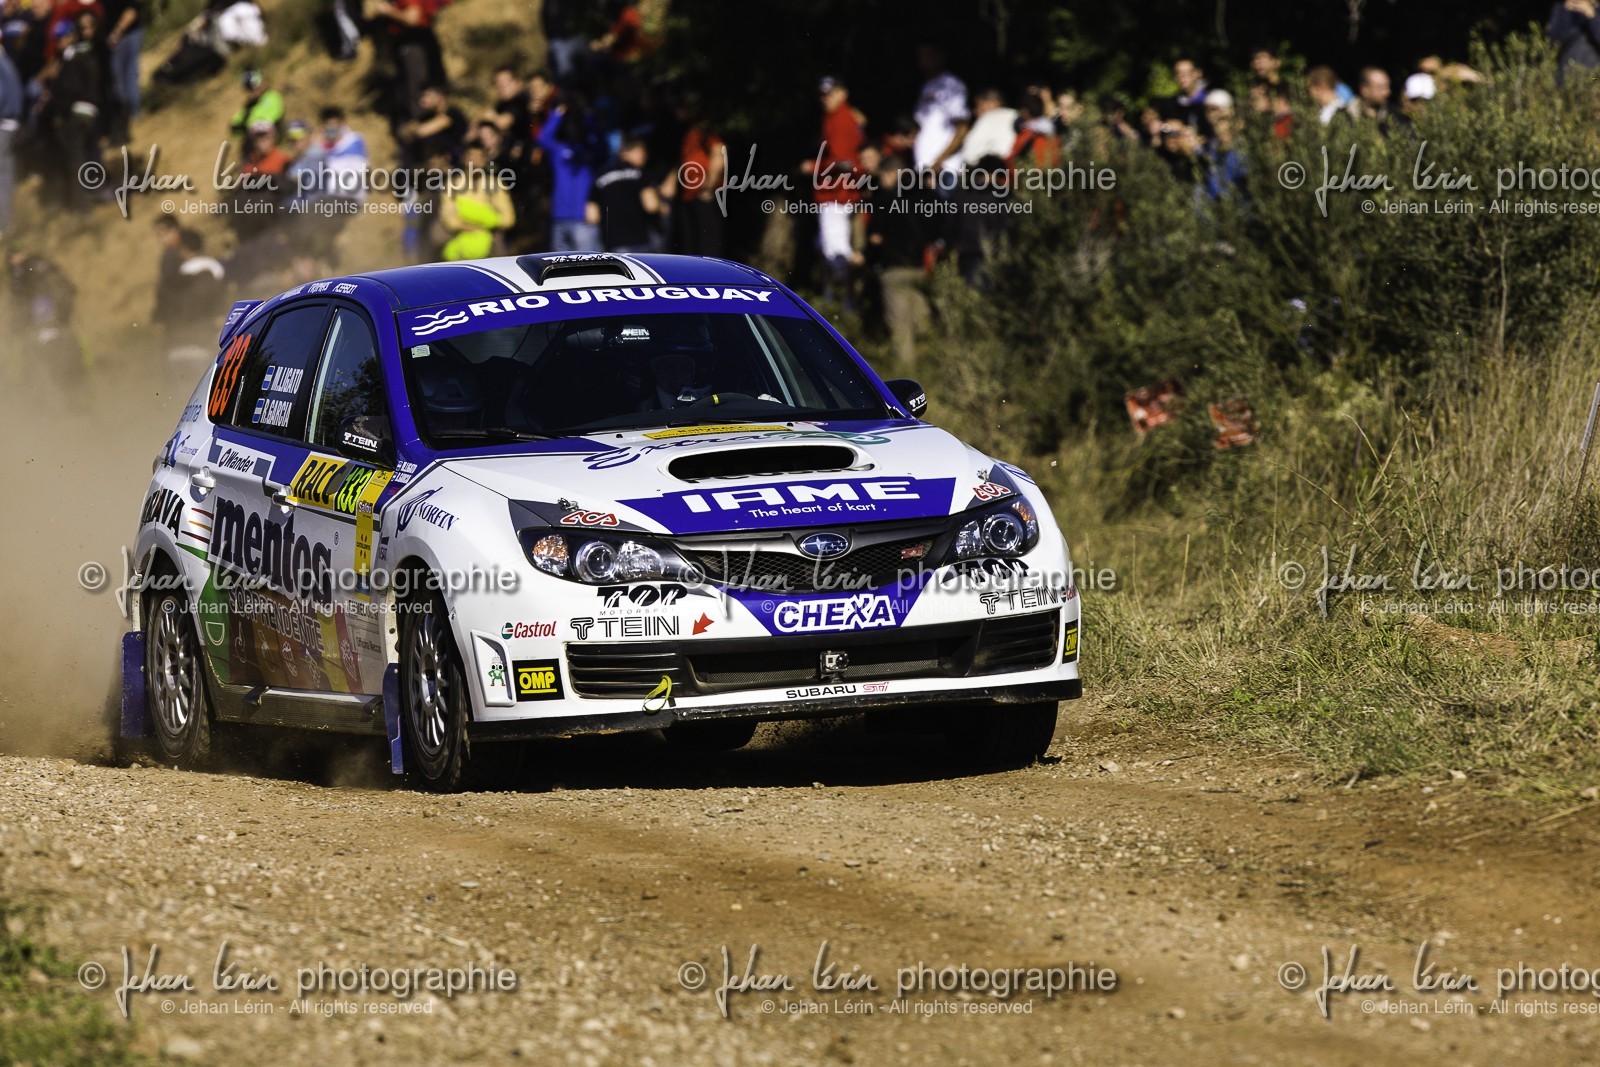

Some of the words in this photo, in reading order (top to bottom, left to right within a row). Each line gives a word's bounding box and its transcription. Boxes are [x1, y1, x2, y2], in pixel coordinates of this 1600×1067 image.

[468, 296, 550, 316] RIO
[557, 287, 772, 305] URUGUAY
[351, 434, 379, 449] TEIN
[226, 450, 254, 473] Wander
[295, 459, 347, 505] RACC
[335, 468, 374, 514] 133
[680, 480, 921, 513] IAME
[415, 501, 460, 532] NORFIN
[748, 507, 769, 519] The
[771, 505, 824, 517] heart
[827, 503, 843, 514] of
[845, 502, 876, 513] kart
[208, 498, 334, 616] mentos
[597, 584, 688, 608] TOP
[1003, 585, 1059, 611] TEIN
[773, 593, 896, 633] CHEXA
[513, 620, 557, 639] Castrol
[597, 615, 680, 638] TEIN
[519, 671, 556, 690] OMP
[785, 684, 857, 699] SUBARU
